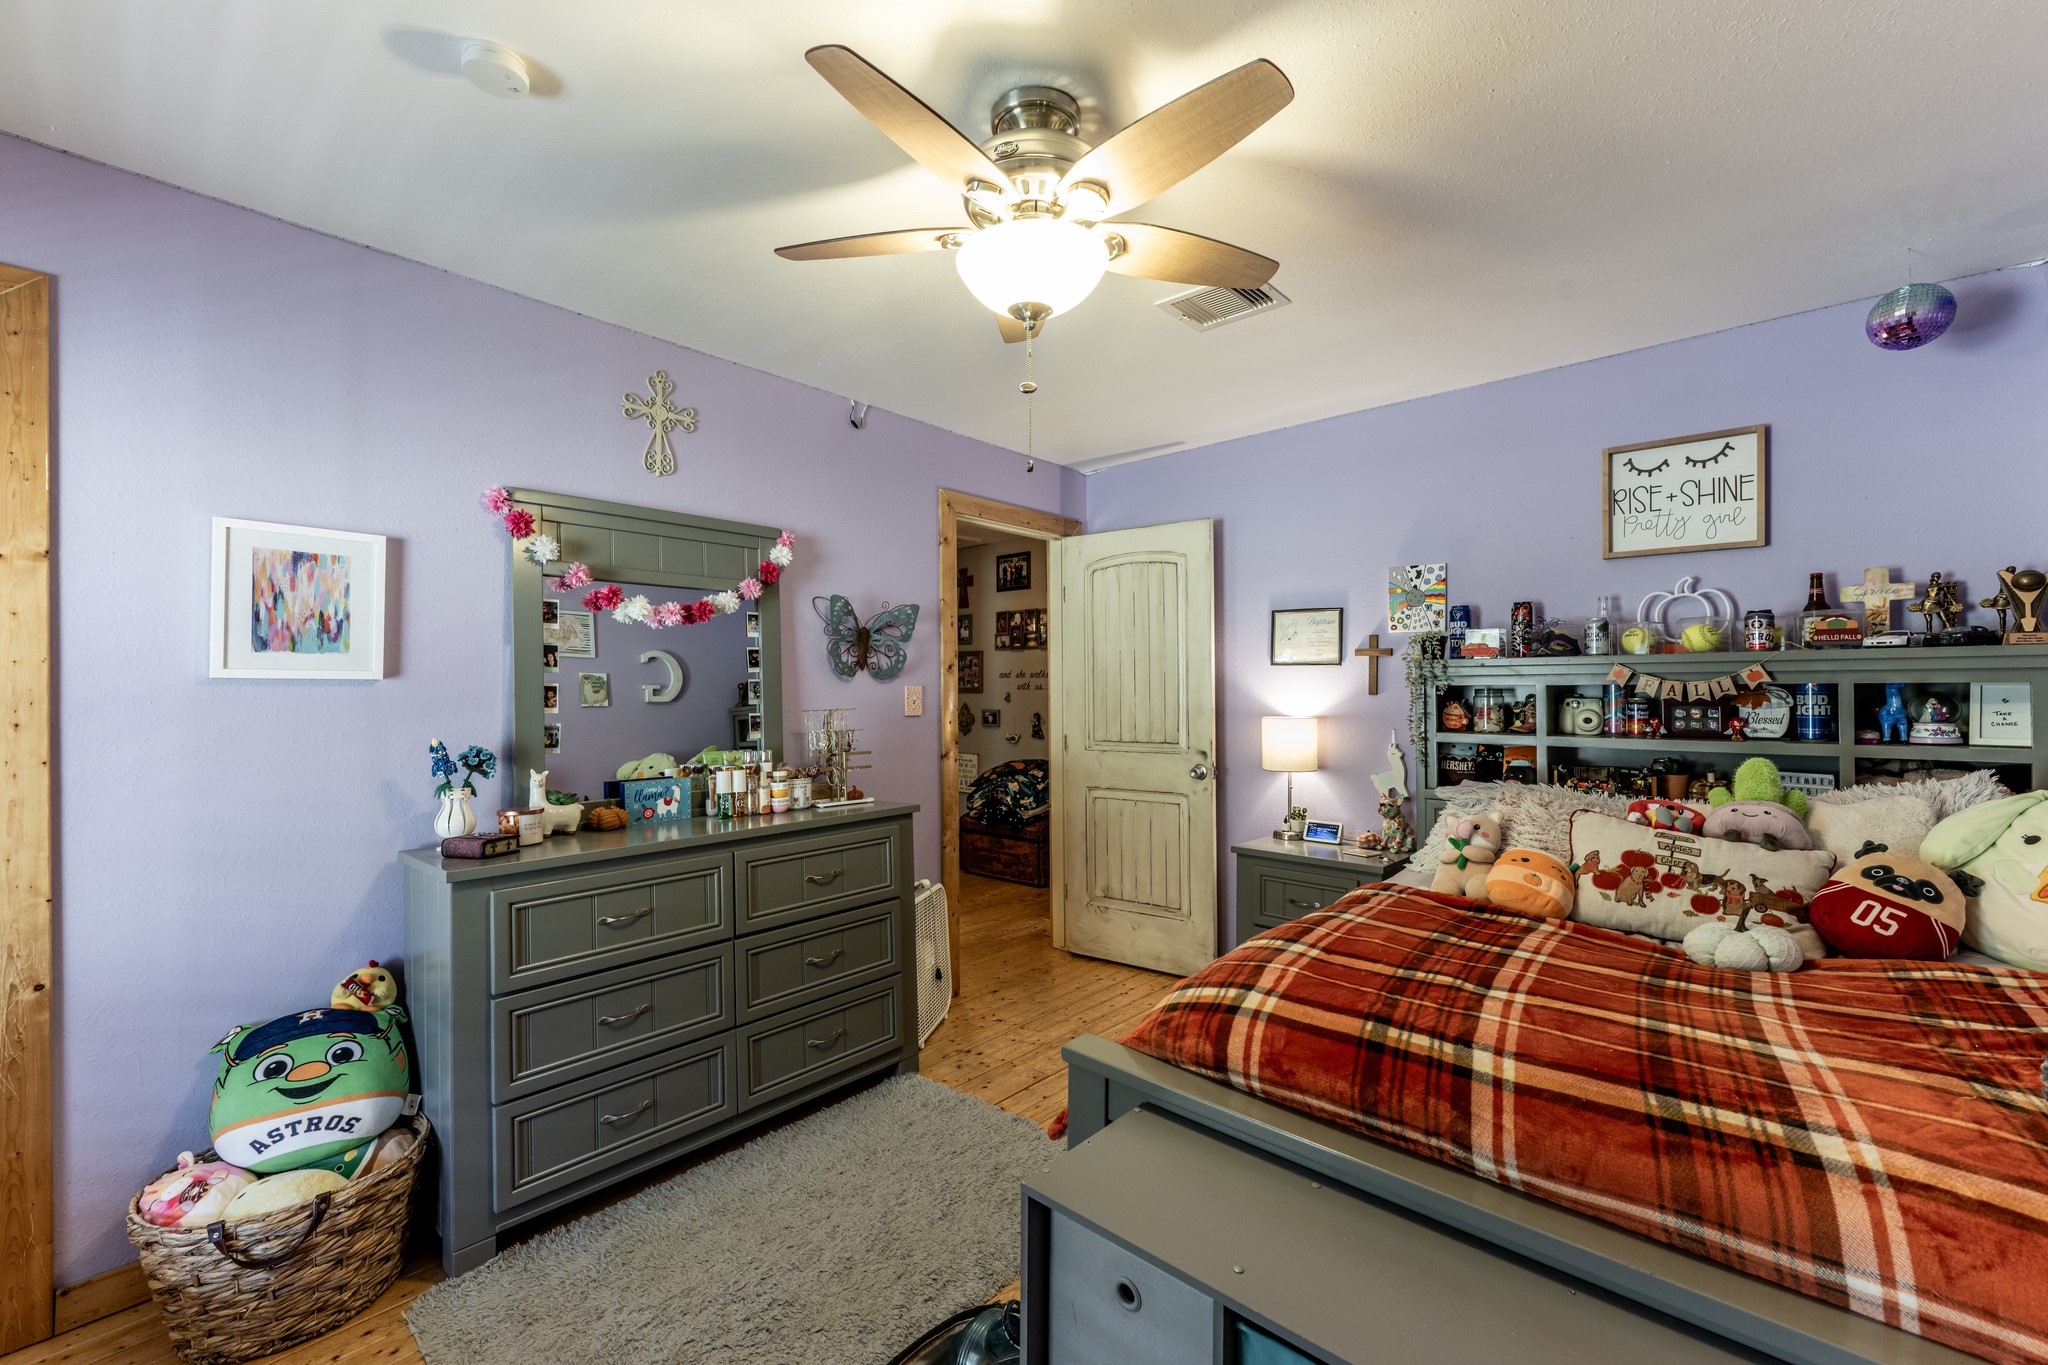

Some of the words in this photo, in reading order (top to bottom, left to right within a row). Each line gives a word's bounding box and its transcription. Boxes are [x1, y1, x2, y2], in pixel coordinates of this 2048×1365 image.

[1613, 484, 1662, 516] RISE
[1680, 474, 1755, 507] SHINE
[1703, 507, 1746, 540] girl
[1853, 586, 1901, 601] Grace
[999, 670, 1012, 679] and
[1015, 669, 1027, 679] she
[1017, 682, 1031, 691] with
[1796, 695, 1829, 705] BUD
[1745, 712, 1785, 725] Blessed
[1781, 776, 1833, 786] PTEMBER
[1850, 900, 1908, 936] 05
[249, 1115, 362, 1155] ASTROS
